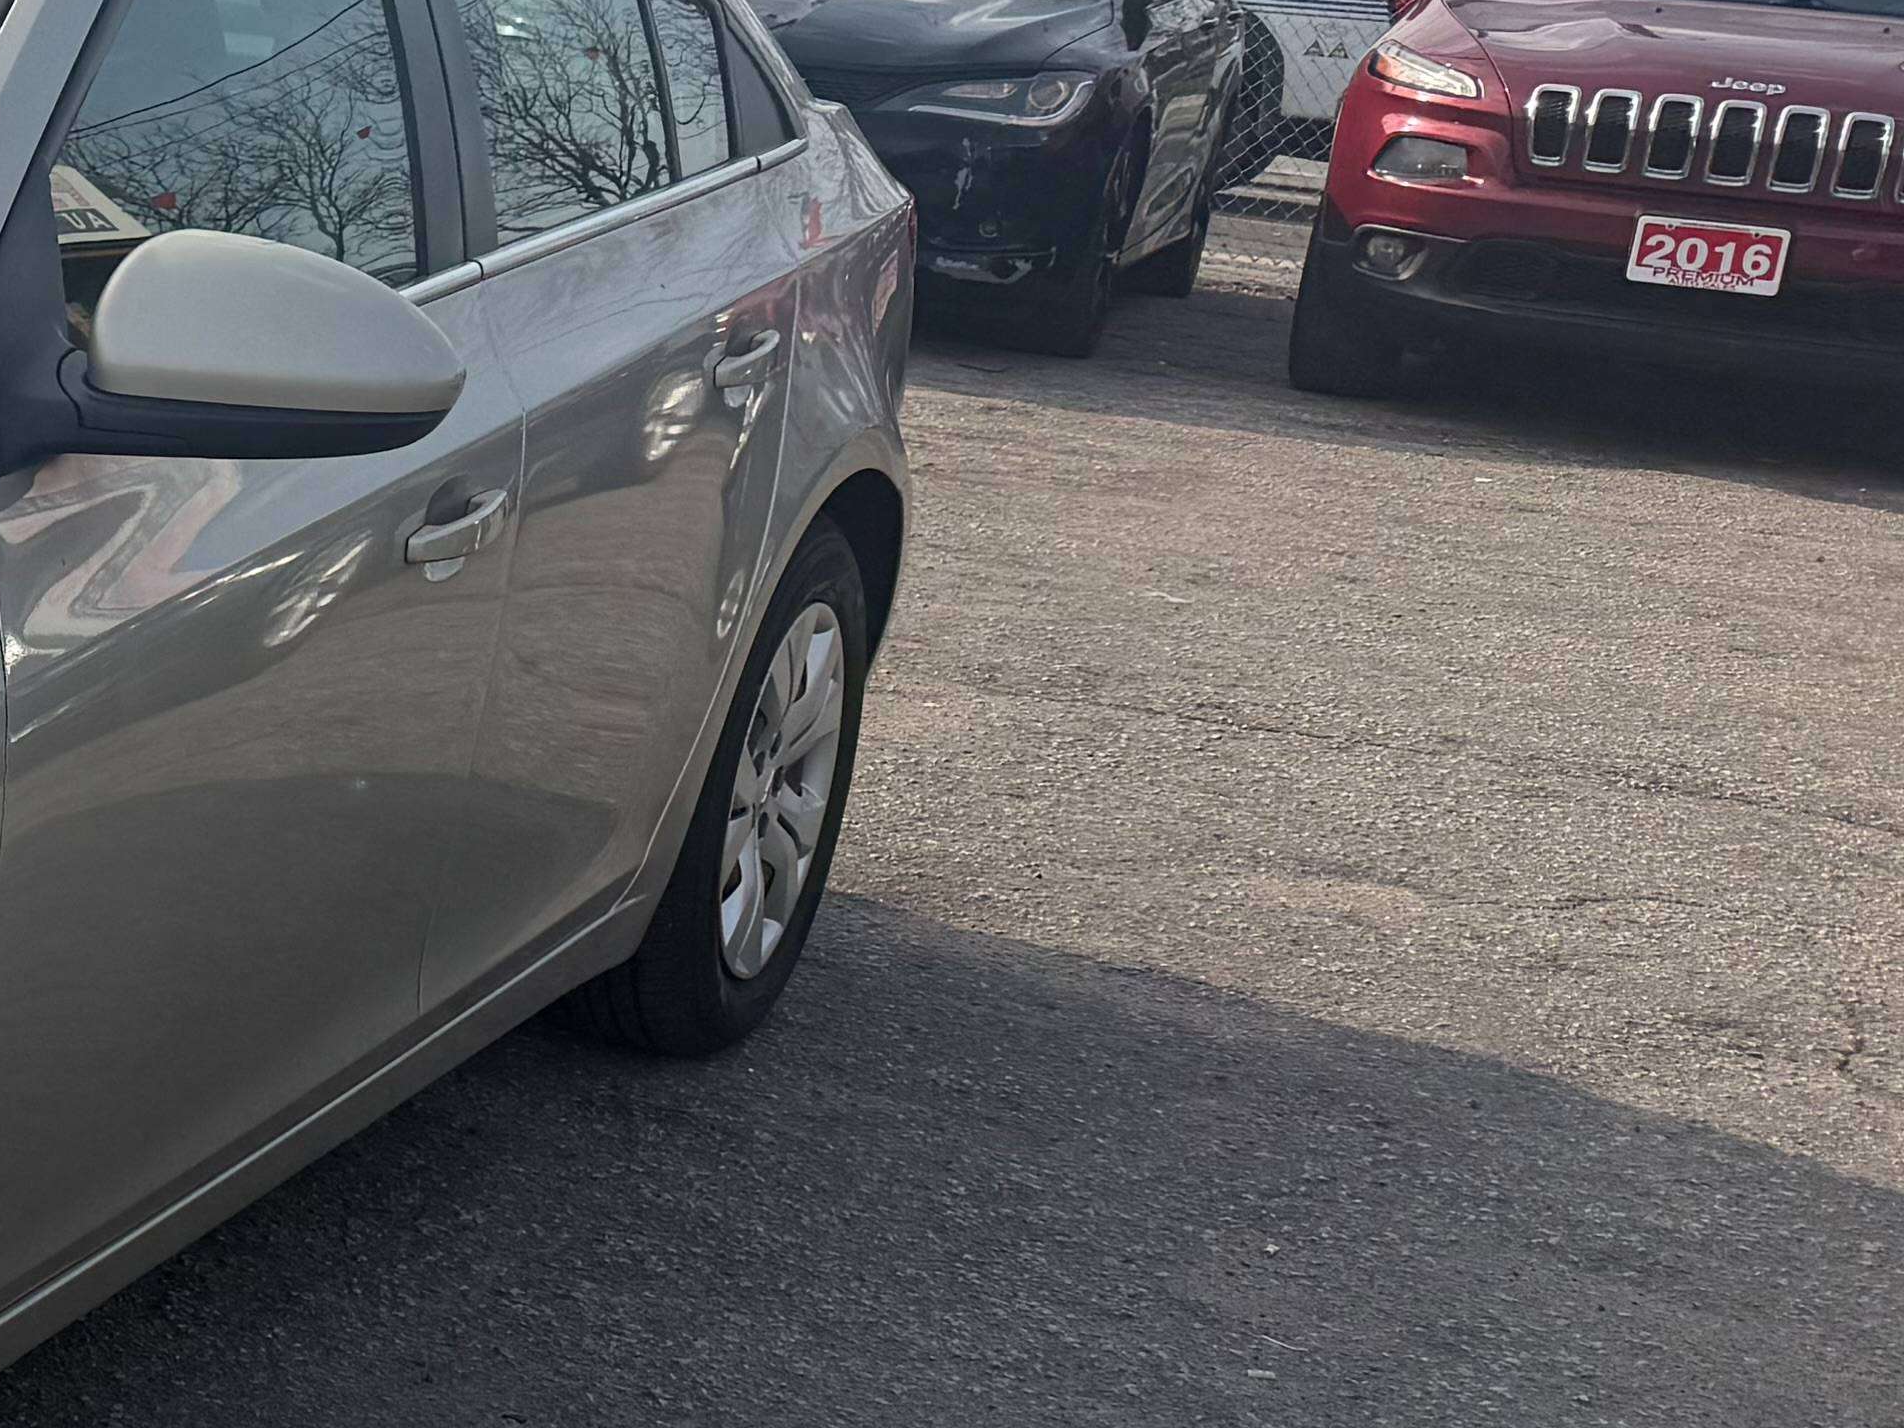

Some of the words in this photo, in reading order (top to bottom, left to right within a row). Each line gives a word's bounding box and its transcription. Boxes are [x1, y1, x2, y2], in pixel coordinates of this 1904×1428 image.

[1711, 77, 1786, 95] Jeep
[1641, 234, 1773, 278] 2016
[1652, 266, 1755, 287] PREMIUM
